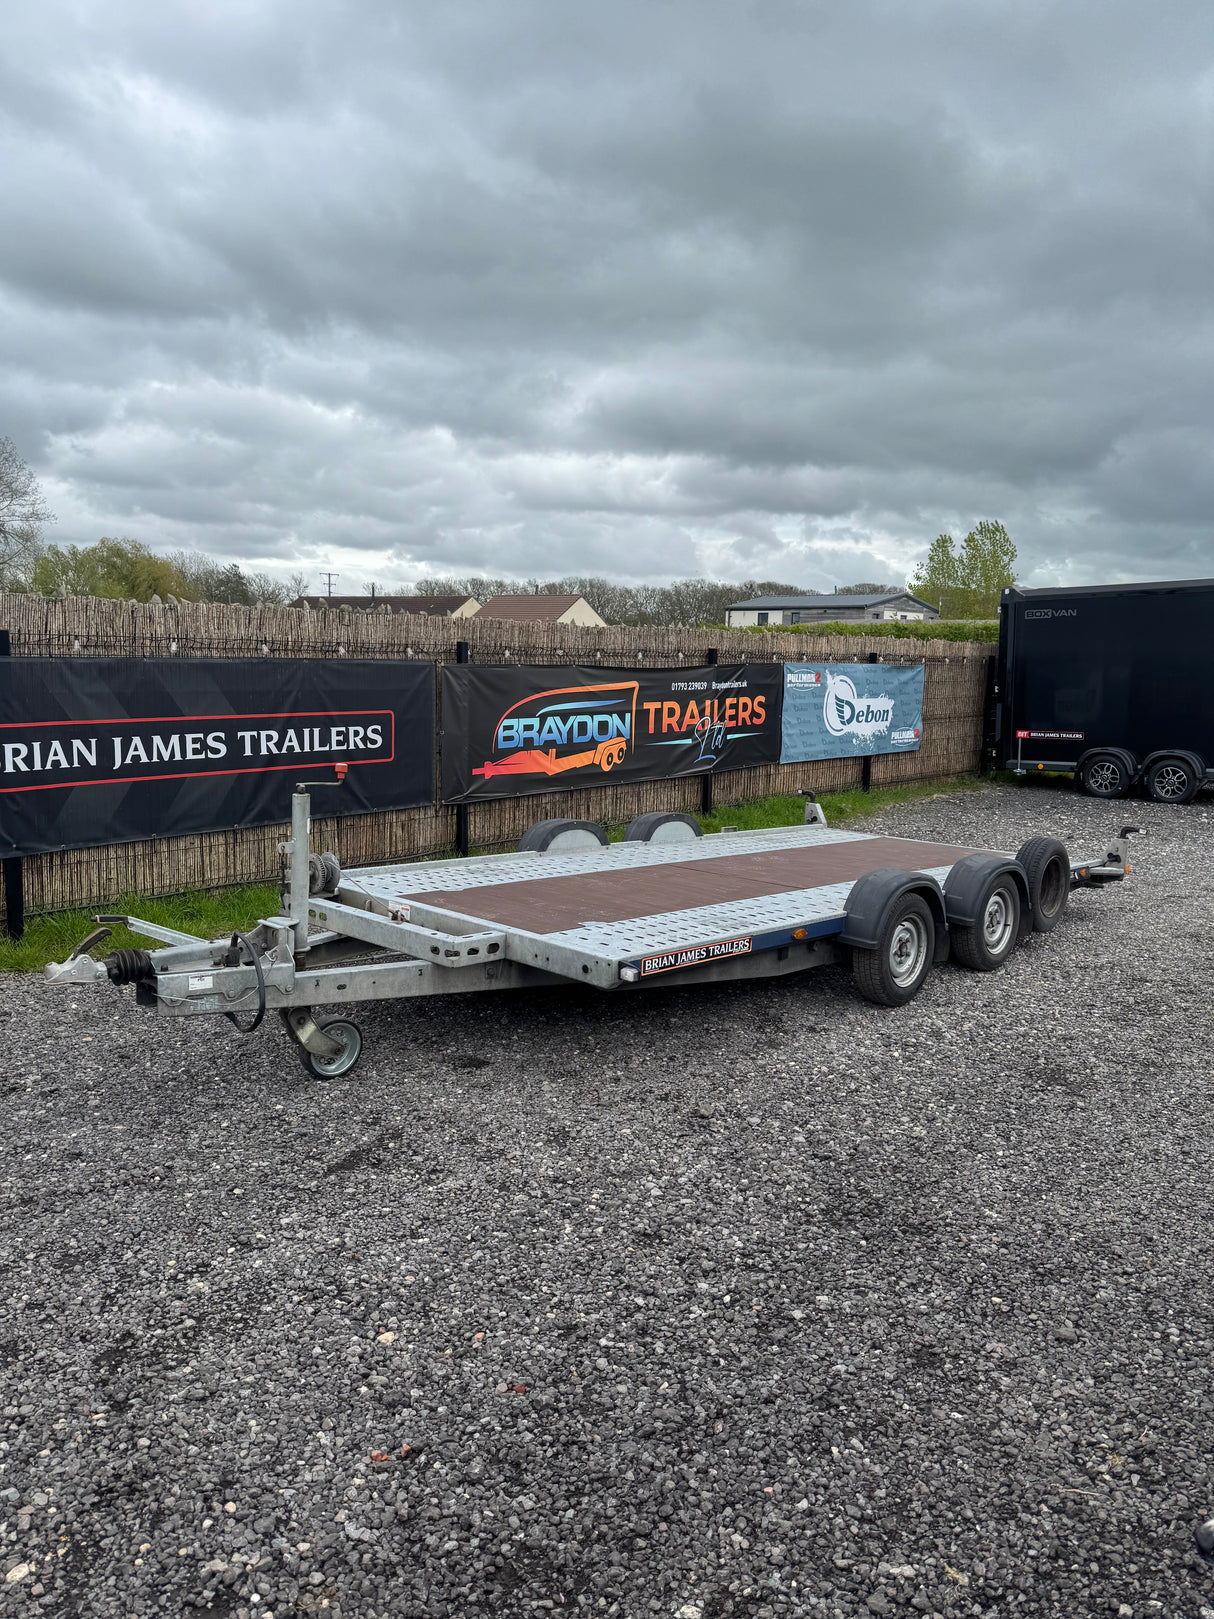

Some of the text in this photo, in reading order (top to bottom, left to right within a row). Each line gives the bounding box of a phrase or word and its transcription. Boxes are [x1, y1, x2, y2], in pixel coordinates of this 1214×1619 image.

[671, 682, 687, 691] 01793
[688, 681, 707, 690] 239039
[643, 695, 766, 734] TRAILERS
[835, 694, 890, 726] Debon
[0, 724, 383, 773] RIAN JAMES TRAILERS
[497, 712, 631, 749] BRAYDON
[694, 716, 727, 763] Ltd
[645, 954, 676, 971] BRIAN
[676, 948, 706, 965] JAMES
[709, 939, 750, 956] TRAILERS
